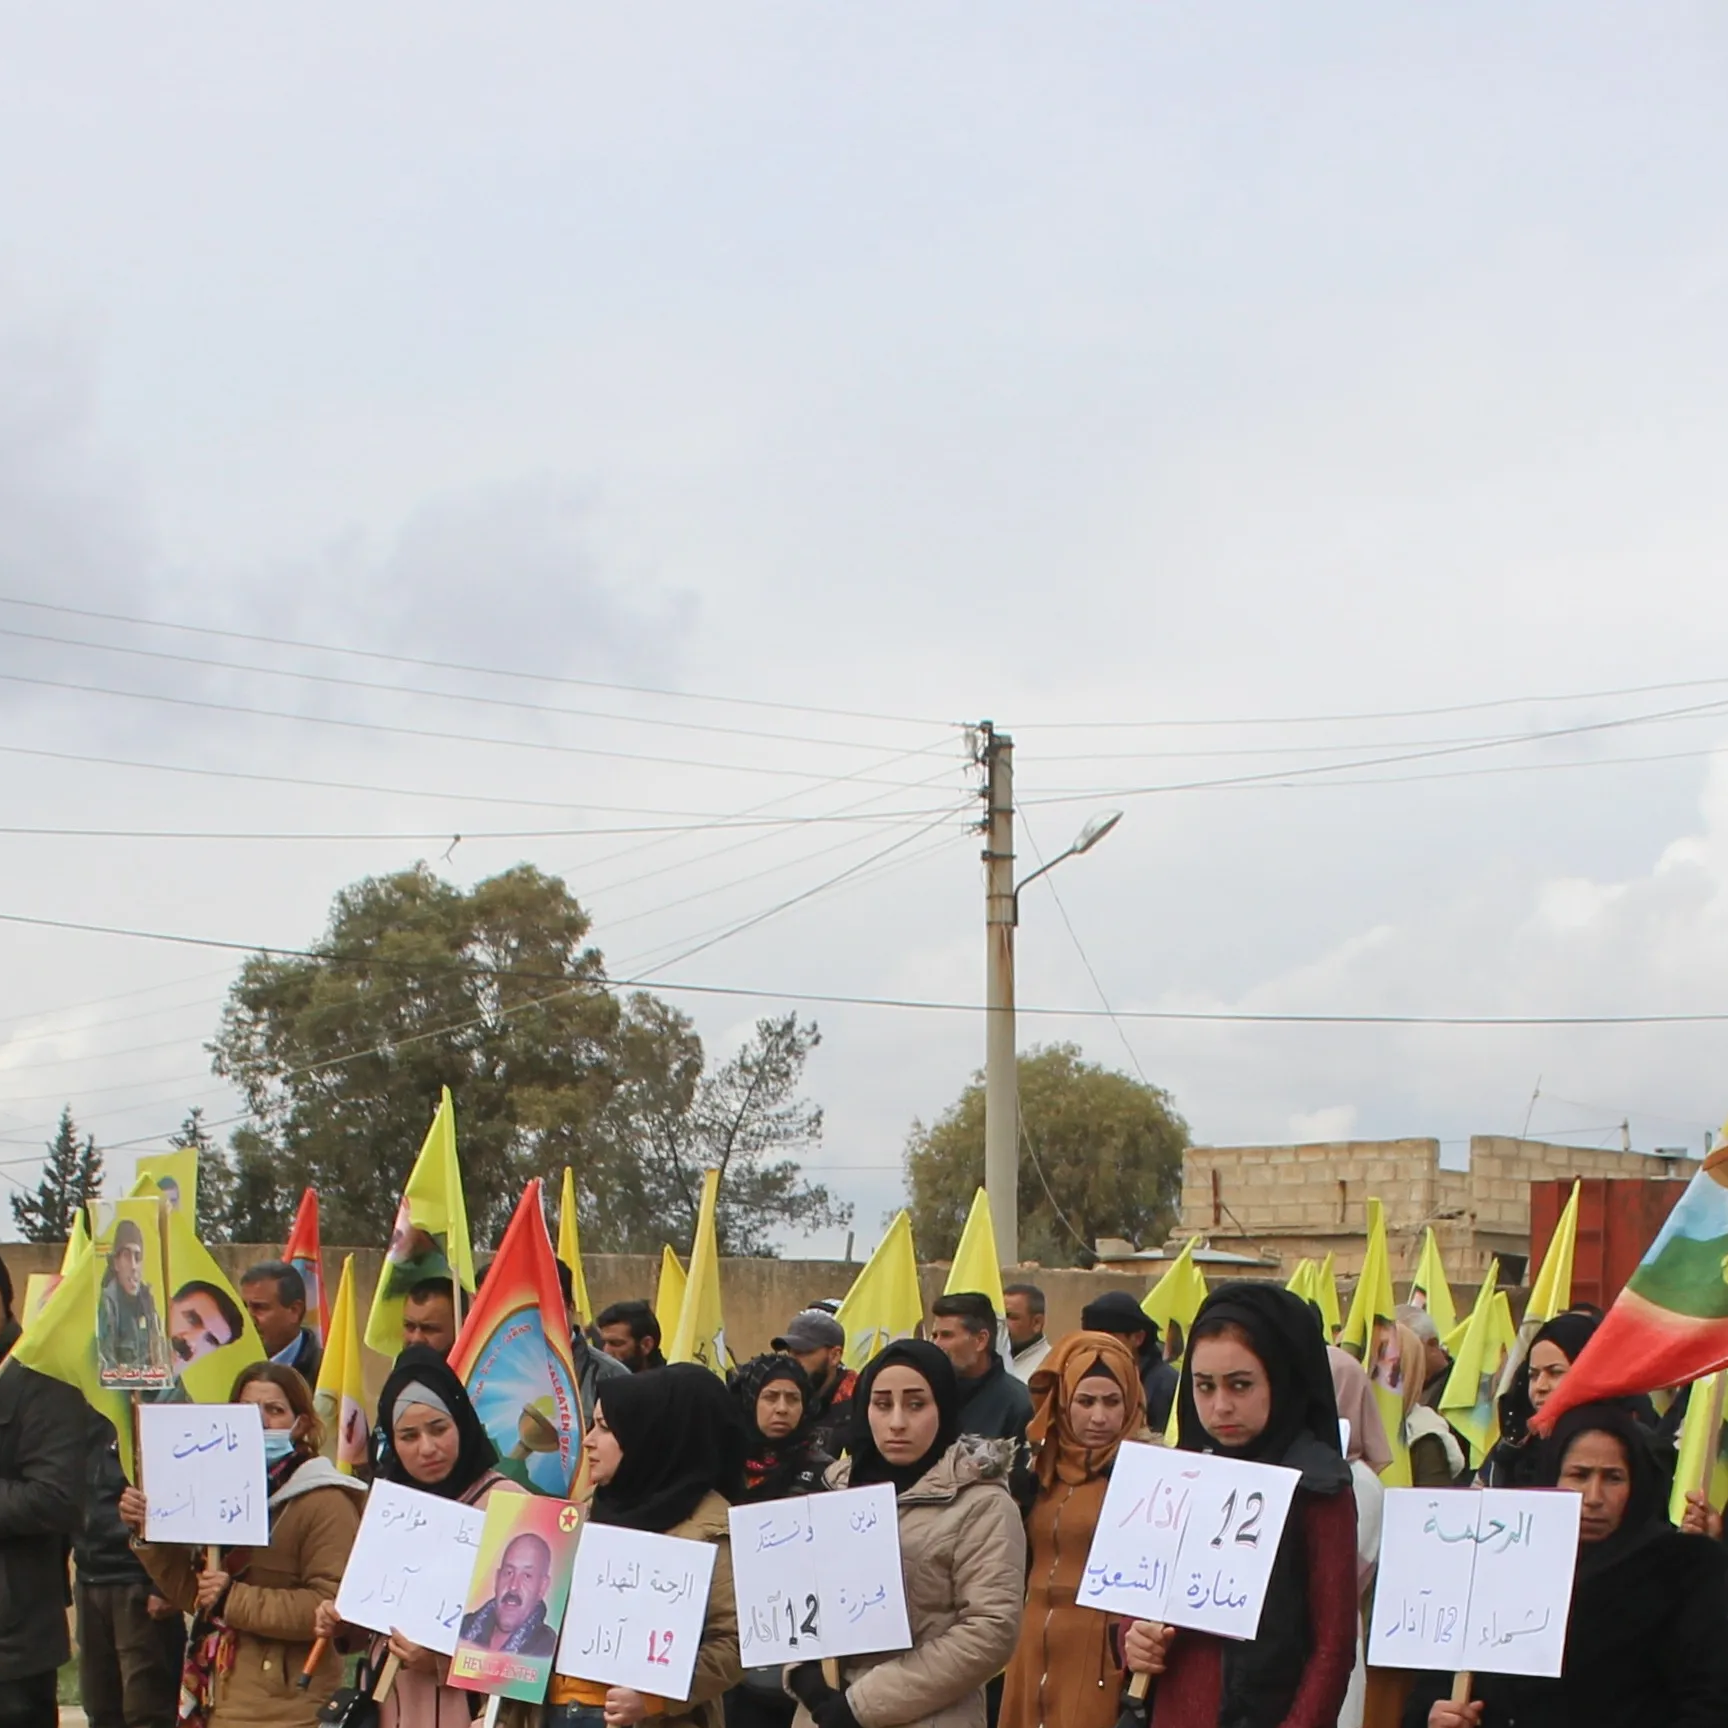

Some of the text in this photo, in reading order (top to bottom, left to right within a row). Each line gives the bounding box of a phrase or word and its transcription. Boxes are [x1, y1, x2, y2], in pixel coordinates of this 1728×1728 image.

[849, 1503, 878, 1533] ندين
[1118, 1470, 1266, 1549] 12 آذار
[1423, 1501, 1534, 1554] الرحمة
[1087, 1556, 1248, 1609] منارة الشعوب
[436, 1599, 463, 1629] 12
[582, 1616, 675, 1665] 12 آذار
[742, 1590, 782, 1649] آذار
[785, 1593, 821, 1649] 12
[1386, 1590, 1432, 1638] آذار
